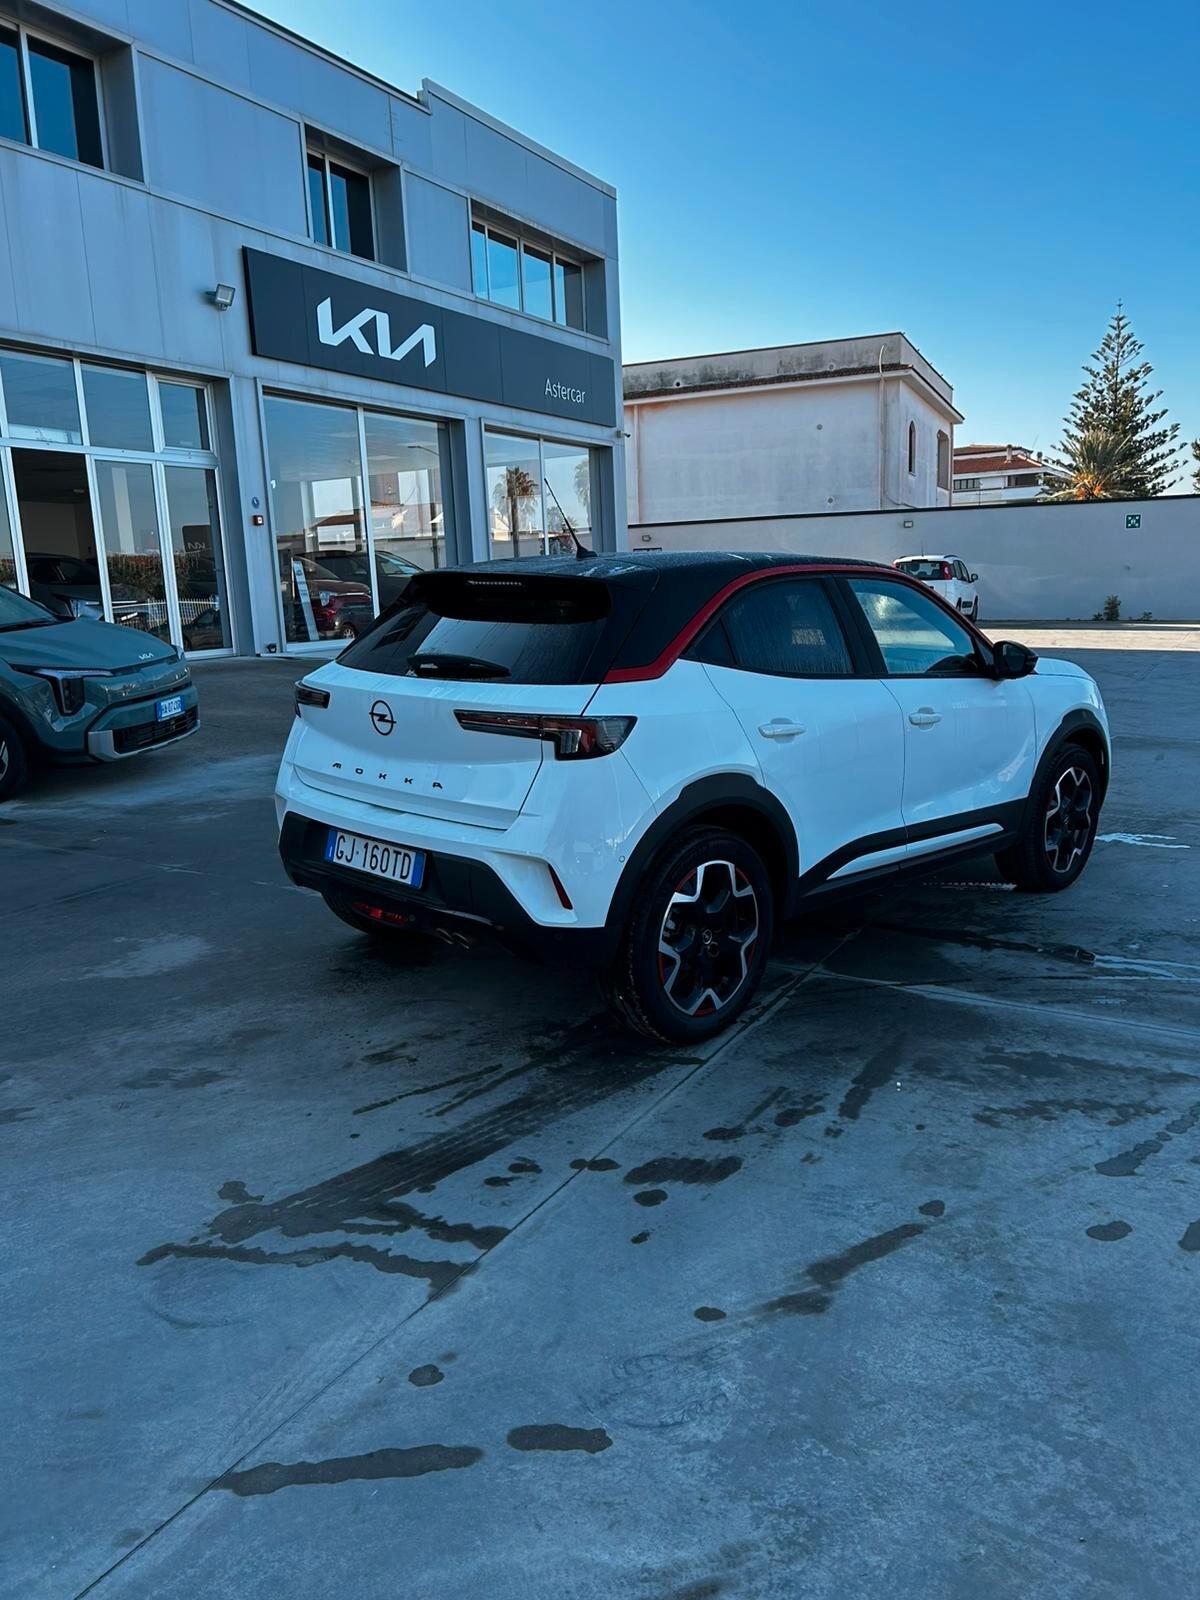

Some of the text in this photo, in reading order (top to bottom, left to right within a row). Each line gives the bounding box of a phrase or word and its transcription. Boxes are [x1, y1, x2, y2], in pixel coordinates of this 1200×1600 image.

[317, 296, 437, 368] KIA
[545, 378, 586, 404] Astercar
[332, 762, 443, 789] MOKKA
